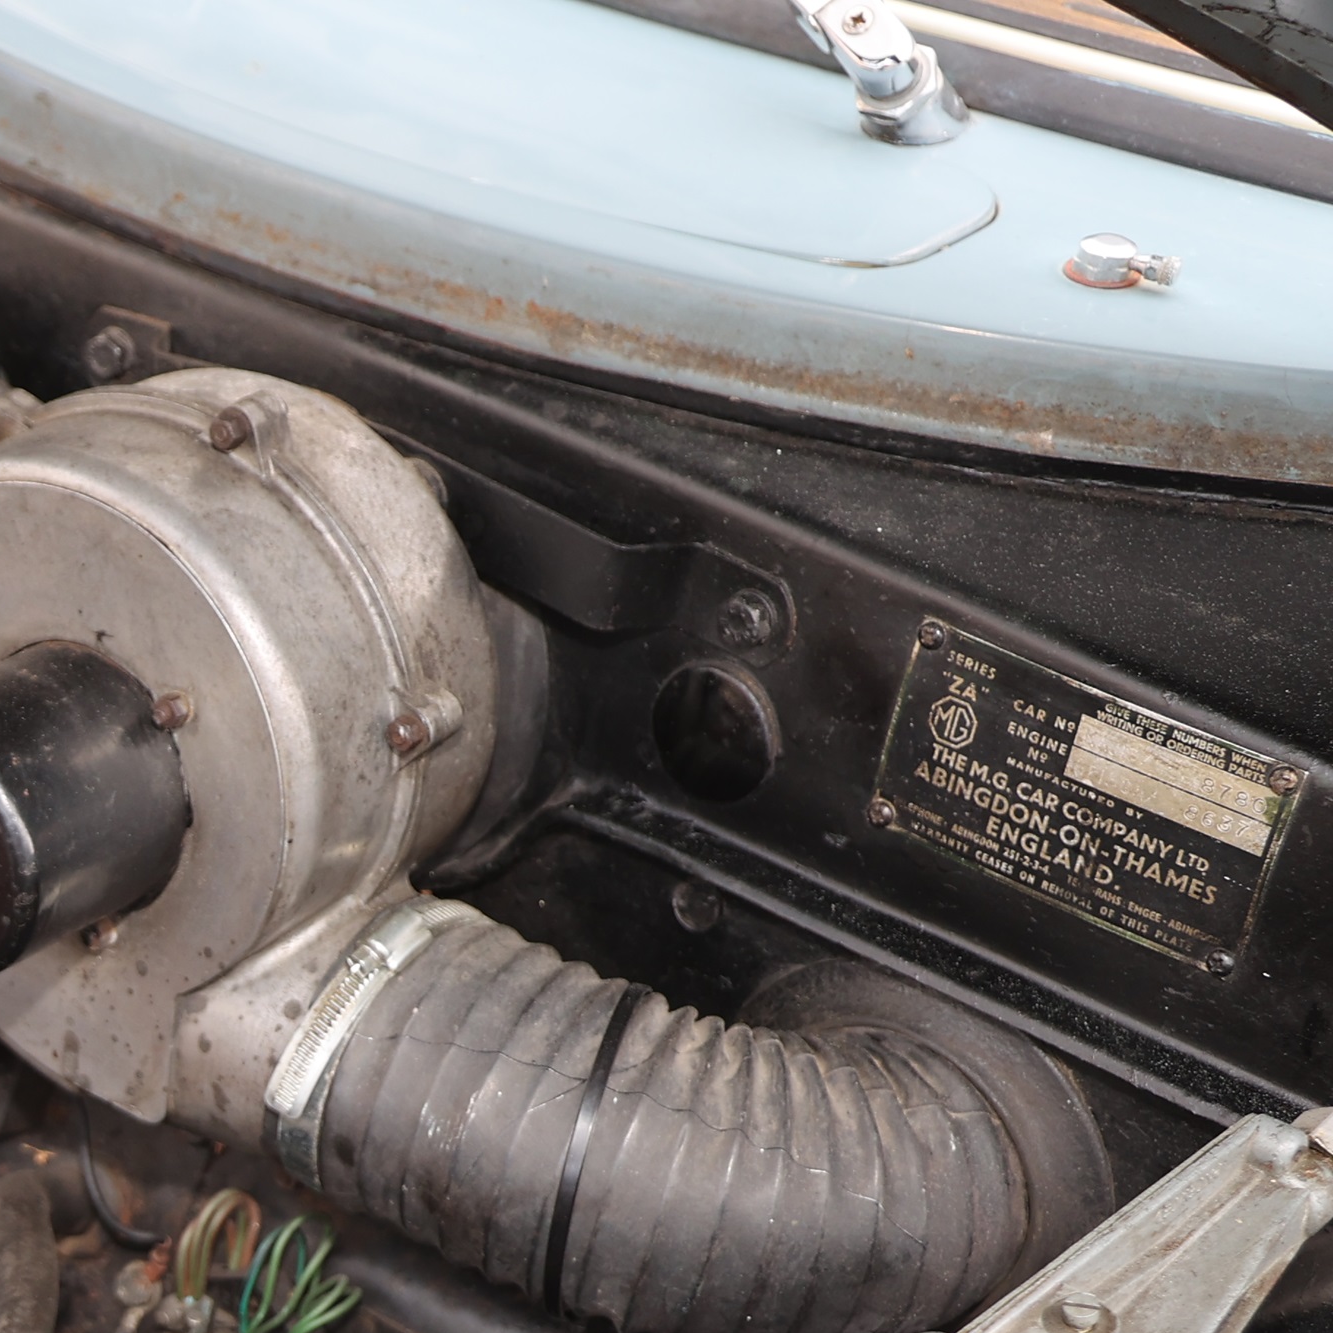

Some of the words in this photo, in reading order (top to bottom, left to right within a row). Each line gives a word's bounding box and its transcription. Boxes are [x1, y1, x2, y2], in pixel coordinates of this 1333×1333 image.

[945, 648, 998, 681] SERIES
[928, 696, 976, 748] MG
[1005, 719, 1070, 757] ENGINE
[1010, 696, 1048, 723] CAR
[1094, 708, 1145, 738] WRITING
[1144, 728, 1165, 746] OR
[1164, 736, 1227, 771] ORDERING
[1103, 700, 1132, 720] GIVE
[1134, 712, 1169, 736] THESE
[1170, 726, 1227, 758] NUMBERS
[1228, 750, 1268, 775] WHEN
[928, 741, 969, 774] THE
[967, 758, 1015, 794] M.G.
[1013, 778, 1061, 814] CAR
[1059, 798, 1174, 862] COMPANY
[1004, 755, 1116, 809] MANUFACTURED
[1123, 804, 1145, 822] BY
[911, 756, 1221, 907] ABINGDON-ON-THAMES
[949, 821, 1000, 853] ABINGDON
[984, 813, 1126, 892] ENGLAND.
[972, 848, 1015, 876] CEASES
[1017, 868, 1036, 886] ON
[1097, 904, 1115, 920] OF
[1119, 913, 1149, 934] THIS
[1153, 927, 1194, 954] PLATE
